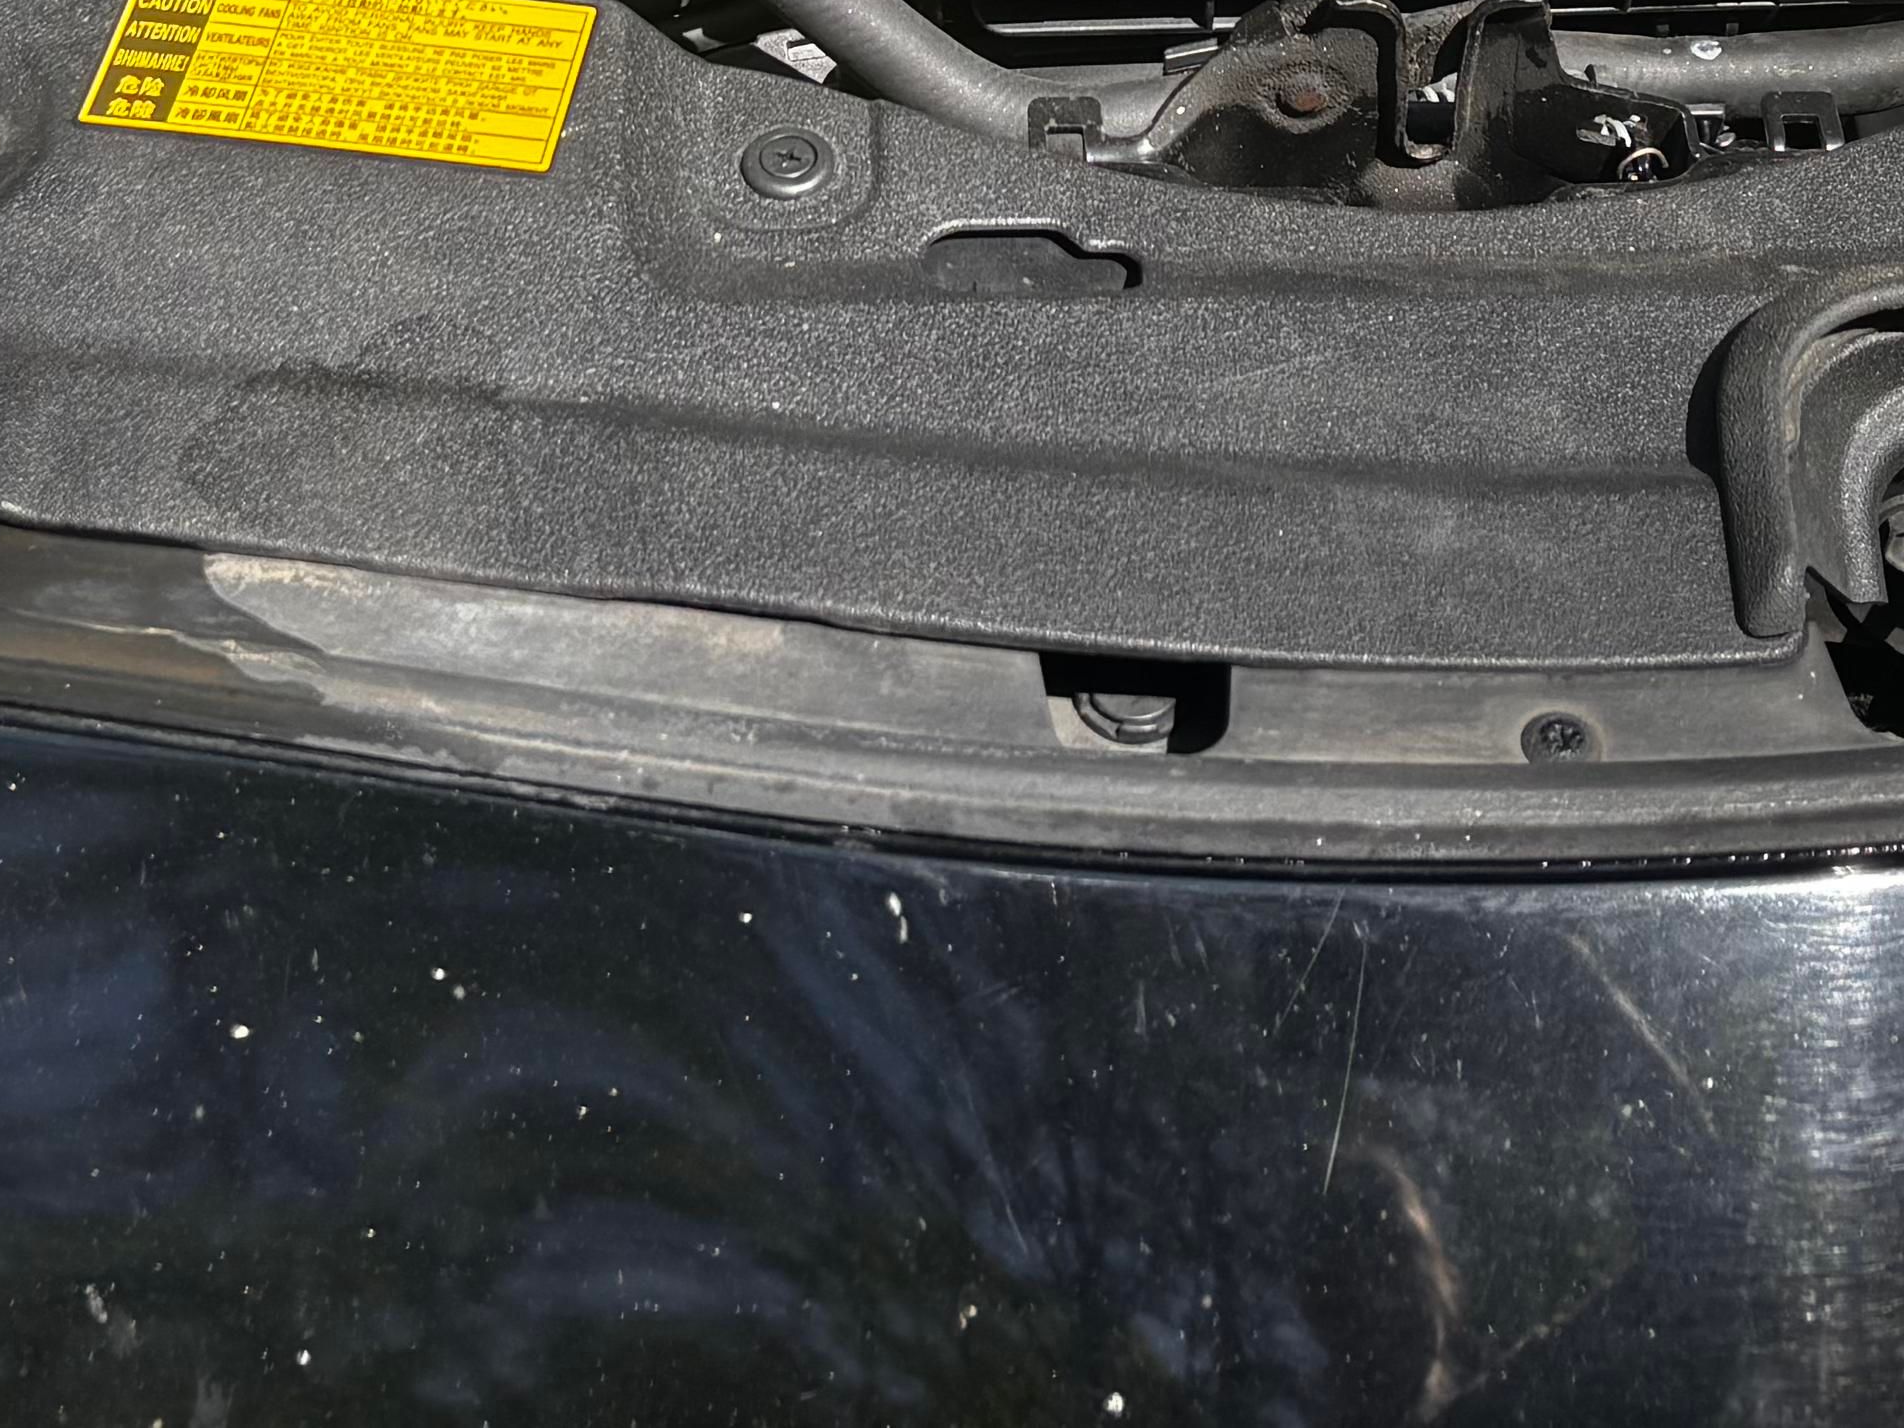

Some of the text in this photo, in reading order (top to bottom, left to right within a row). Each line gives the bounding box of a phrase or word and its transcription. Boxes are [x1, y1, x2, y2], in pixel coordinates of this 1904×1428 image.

[215, 2, 282, 19] COOLING FANS
[124, 19, 202, 44] ATTENTION
